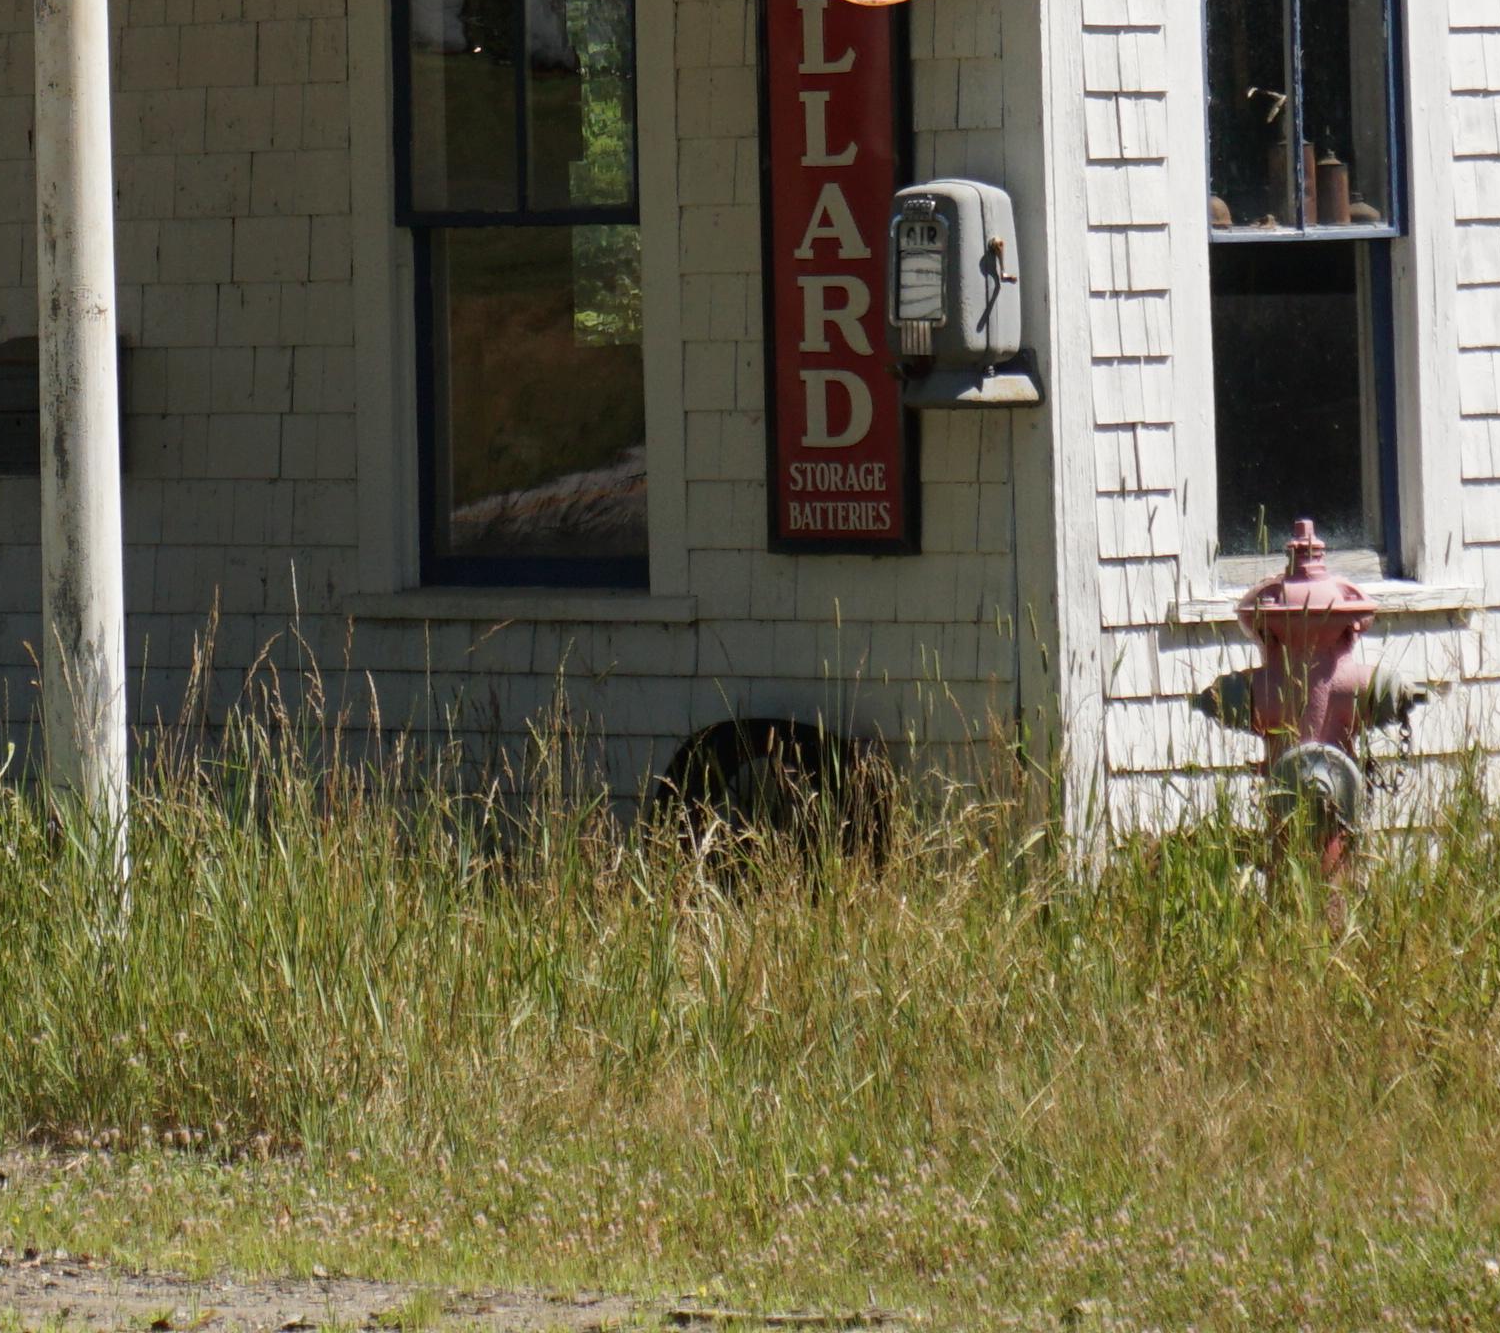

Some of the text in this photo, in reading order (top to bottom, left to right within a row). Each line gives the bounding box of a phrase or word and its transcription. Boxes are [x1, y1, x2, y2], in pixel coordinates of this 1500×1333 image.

[905, 225, 938, 245] AIR
[790, 462, 887, 492] STORAGE
[788, 500, 891, 530] BATTERIES
